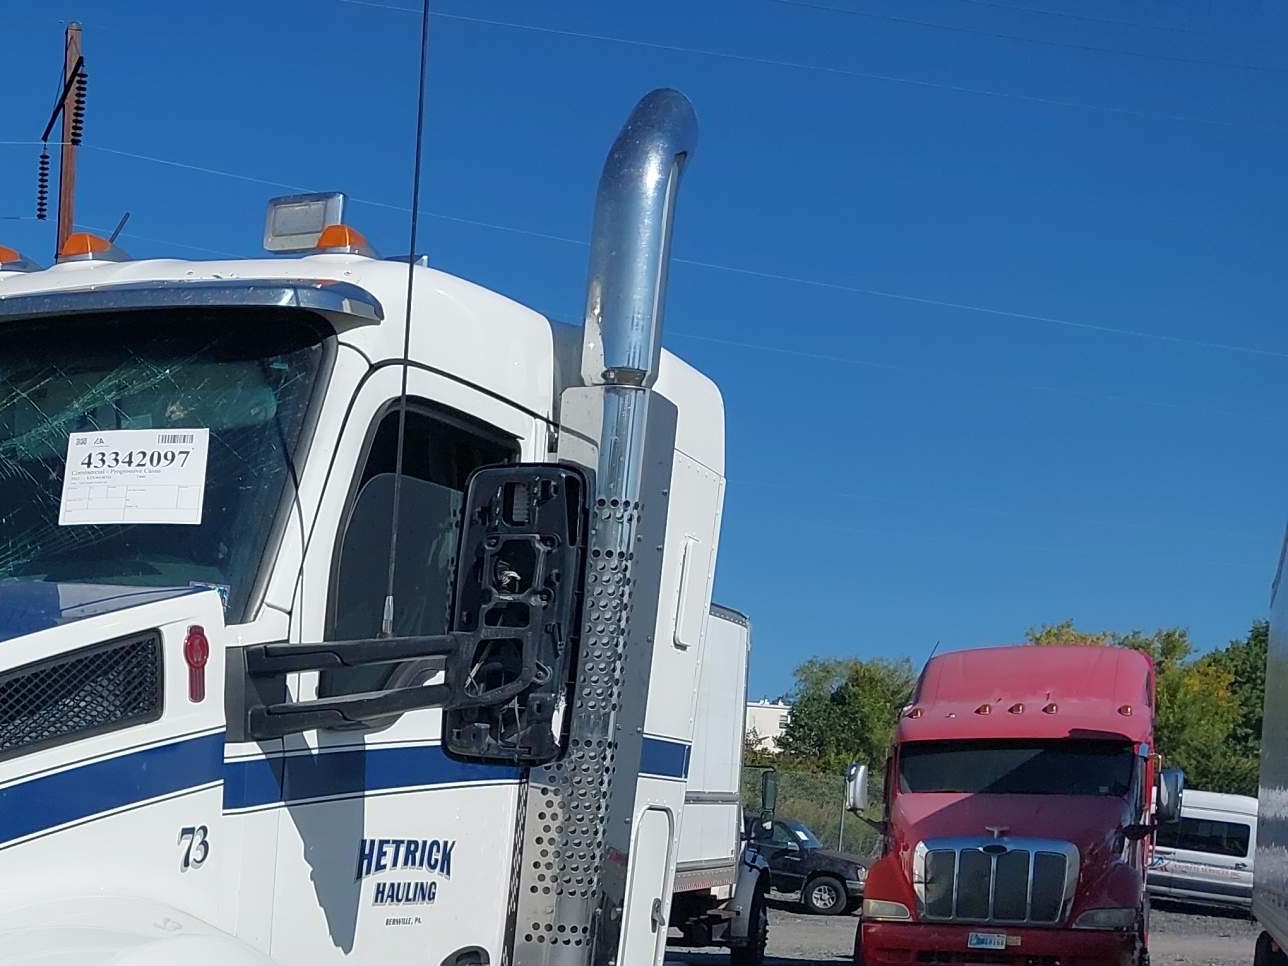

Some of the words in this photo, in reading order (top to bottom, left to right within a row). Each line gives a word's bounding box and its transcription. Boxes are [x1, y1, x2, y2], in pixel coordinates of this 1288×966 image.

[80, 450, 191, 469] 43342097
[178, 825, 210, 871] 73
[355, 838, 456, 882] HETRICK
[373, 881, 437, 905] HAULING
